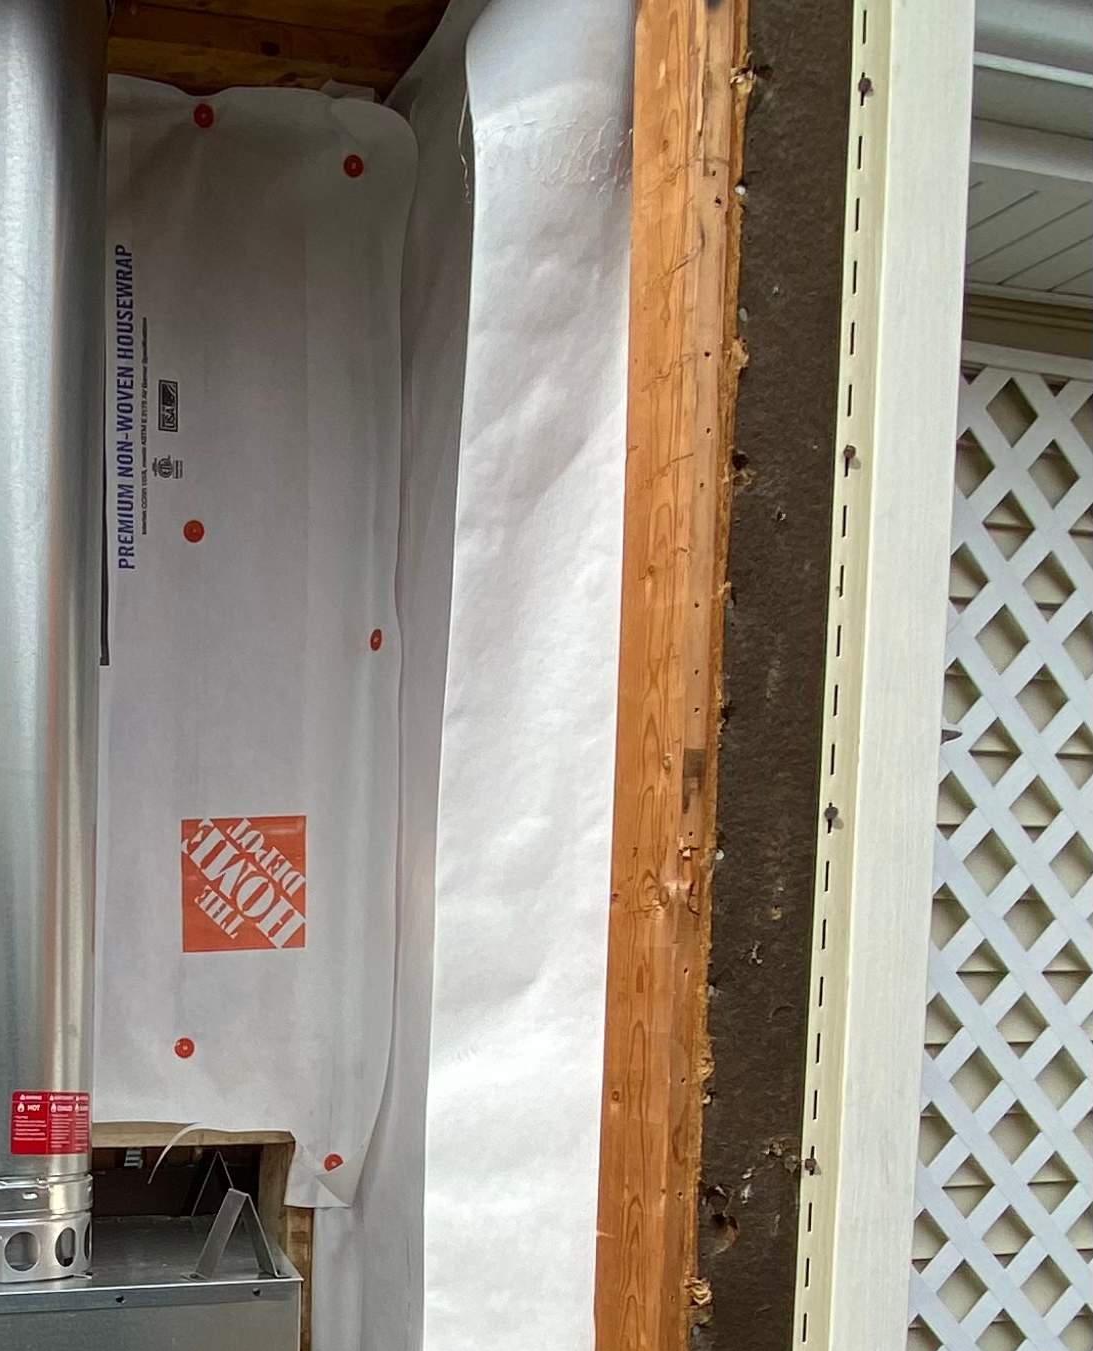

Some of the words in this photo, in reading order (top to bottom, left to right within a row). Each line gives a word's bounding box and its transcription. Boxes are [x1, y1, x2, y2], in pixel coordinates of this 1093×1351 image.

[114, 244, 134, 361] HOUSEWRAP
[116, 366, 135, 479] NON-WOVEN
[164, 407, 176, 429] USA
[116, 484, 135, 570] PREMIUM
[182, 818, 307, 949] HOME
[226, 818, 306, 896] DEPOT
[195, 885, 244, 939] THE
